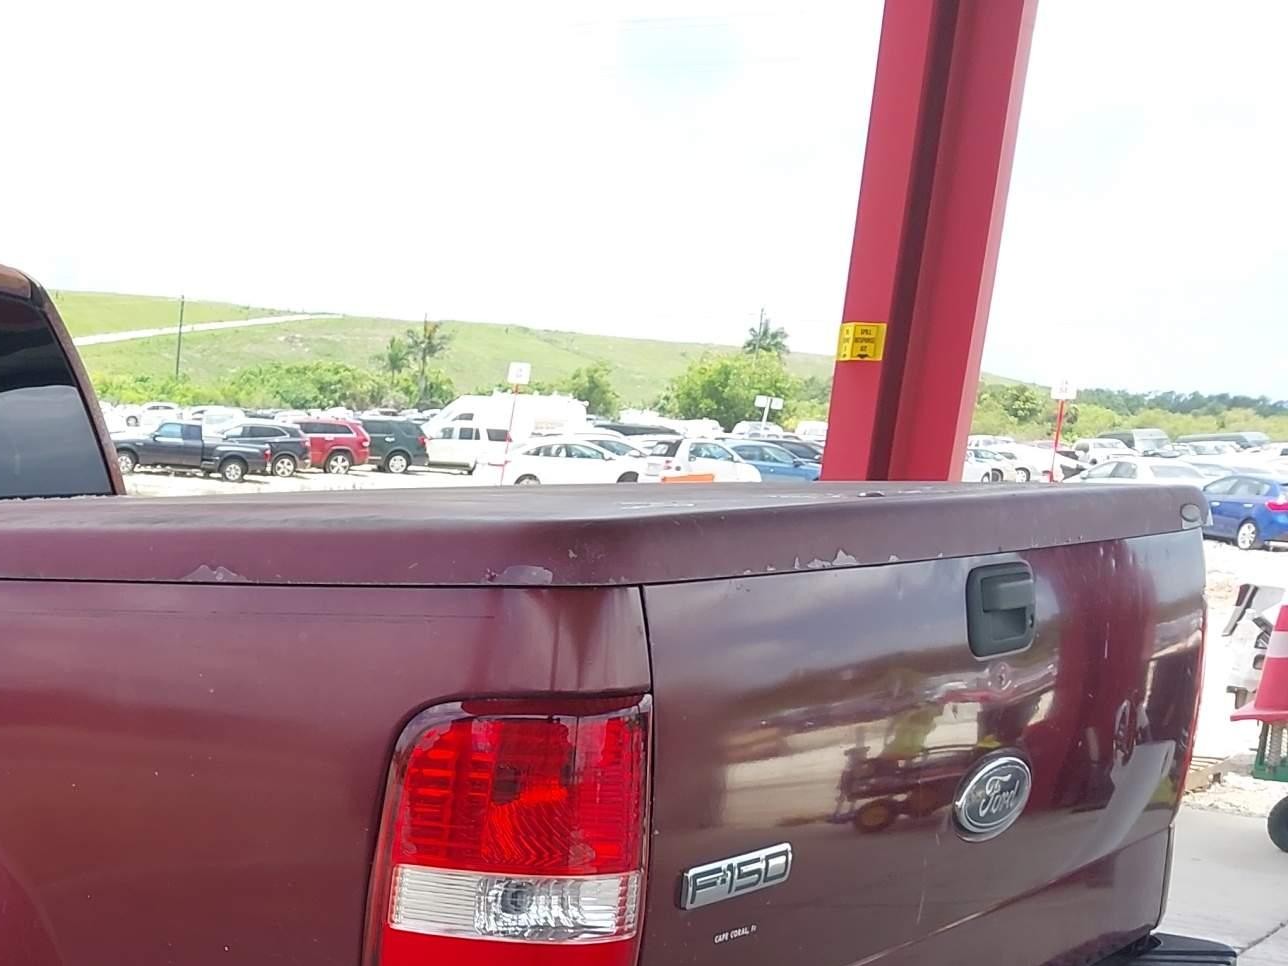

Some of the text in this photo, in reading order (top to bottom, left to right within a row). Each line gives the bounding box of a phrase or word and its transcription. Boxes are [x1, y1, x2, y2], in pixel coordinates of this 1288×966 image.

[979, 773, 1020, 817] Ford
[690, 848, 789, 905] F-150
[714, 931, 729, 944] CAPE
